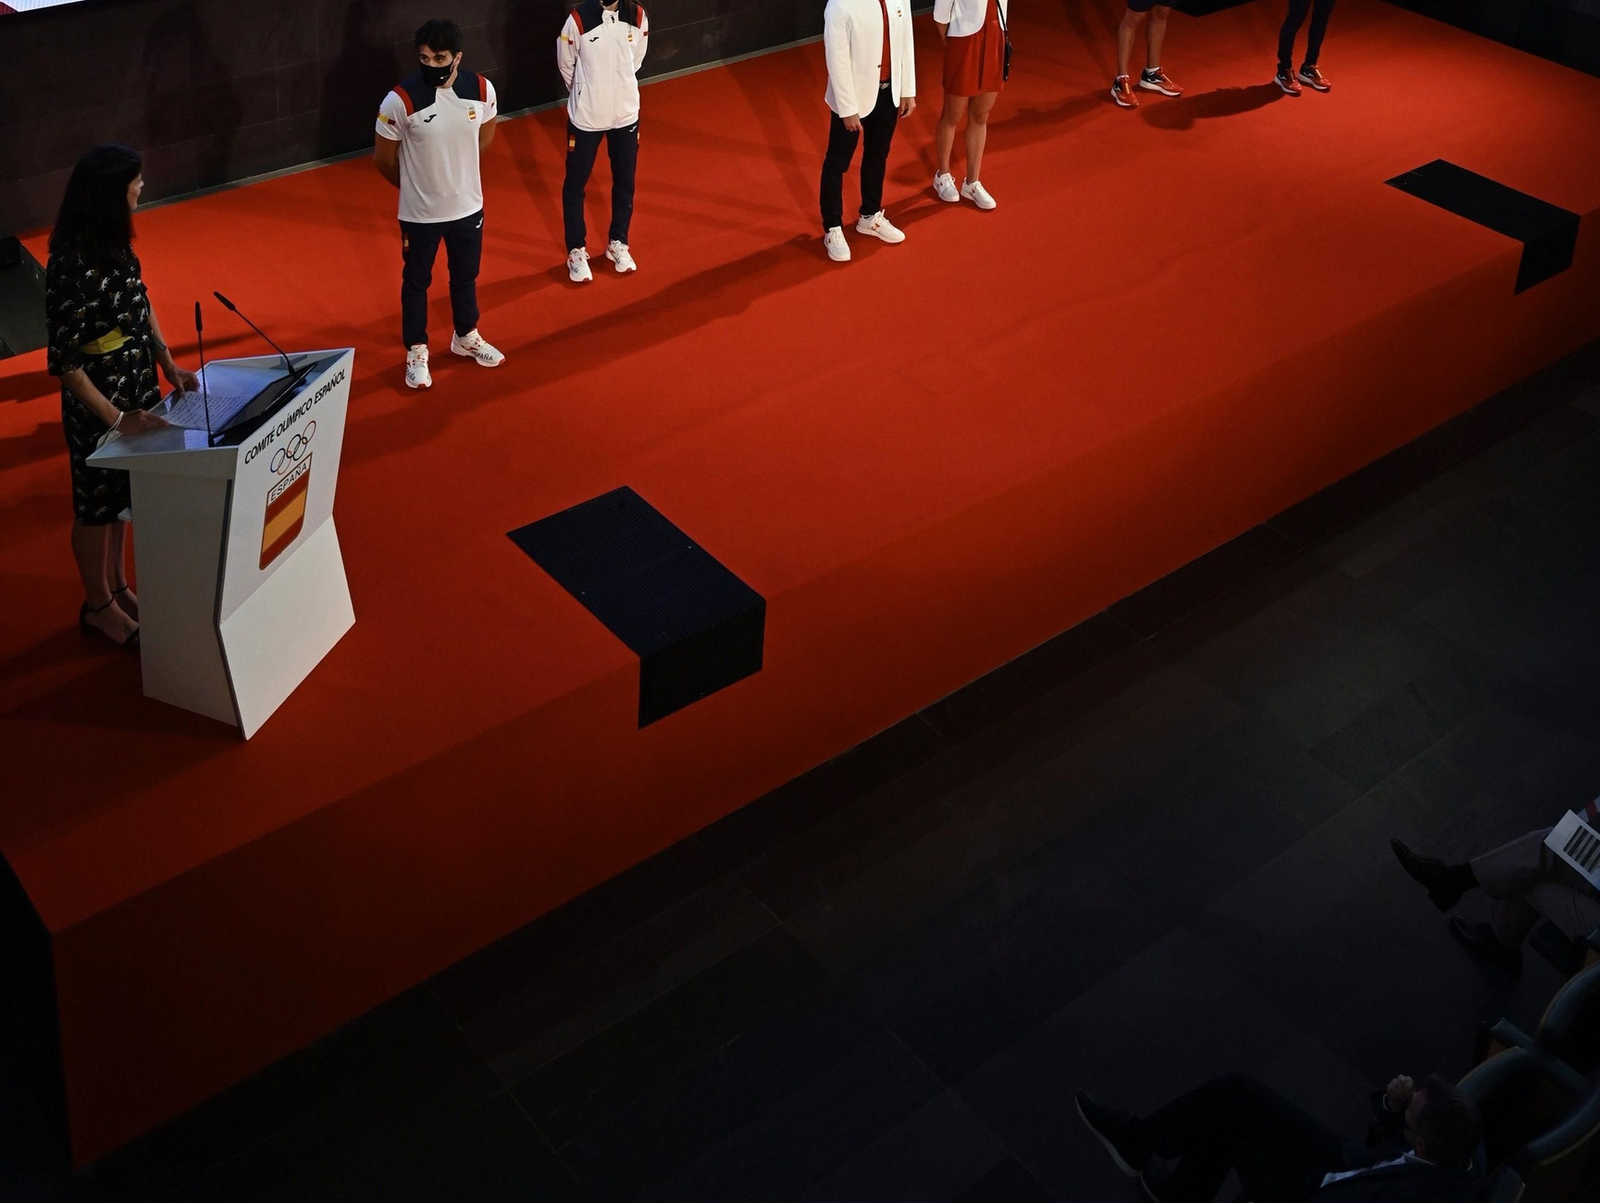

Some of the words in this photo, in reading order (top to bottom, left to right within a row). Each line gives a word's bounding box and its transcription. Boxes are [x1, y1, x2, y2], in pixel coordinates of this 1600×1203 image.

[244, 425, 275, 465] COMITÉ
[276, 397, 313, 437] OLÍMPICO
[313, 368, 346, 405] ESPAÑOL
[270, 462, 307, 502] ESPAÑA
